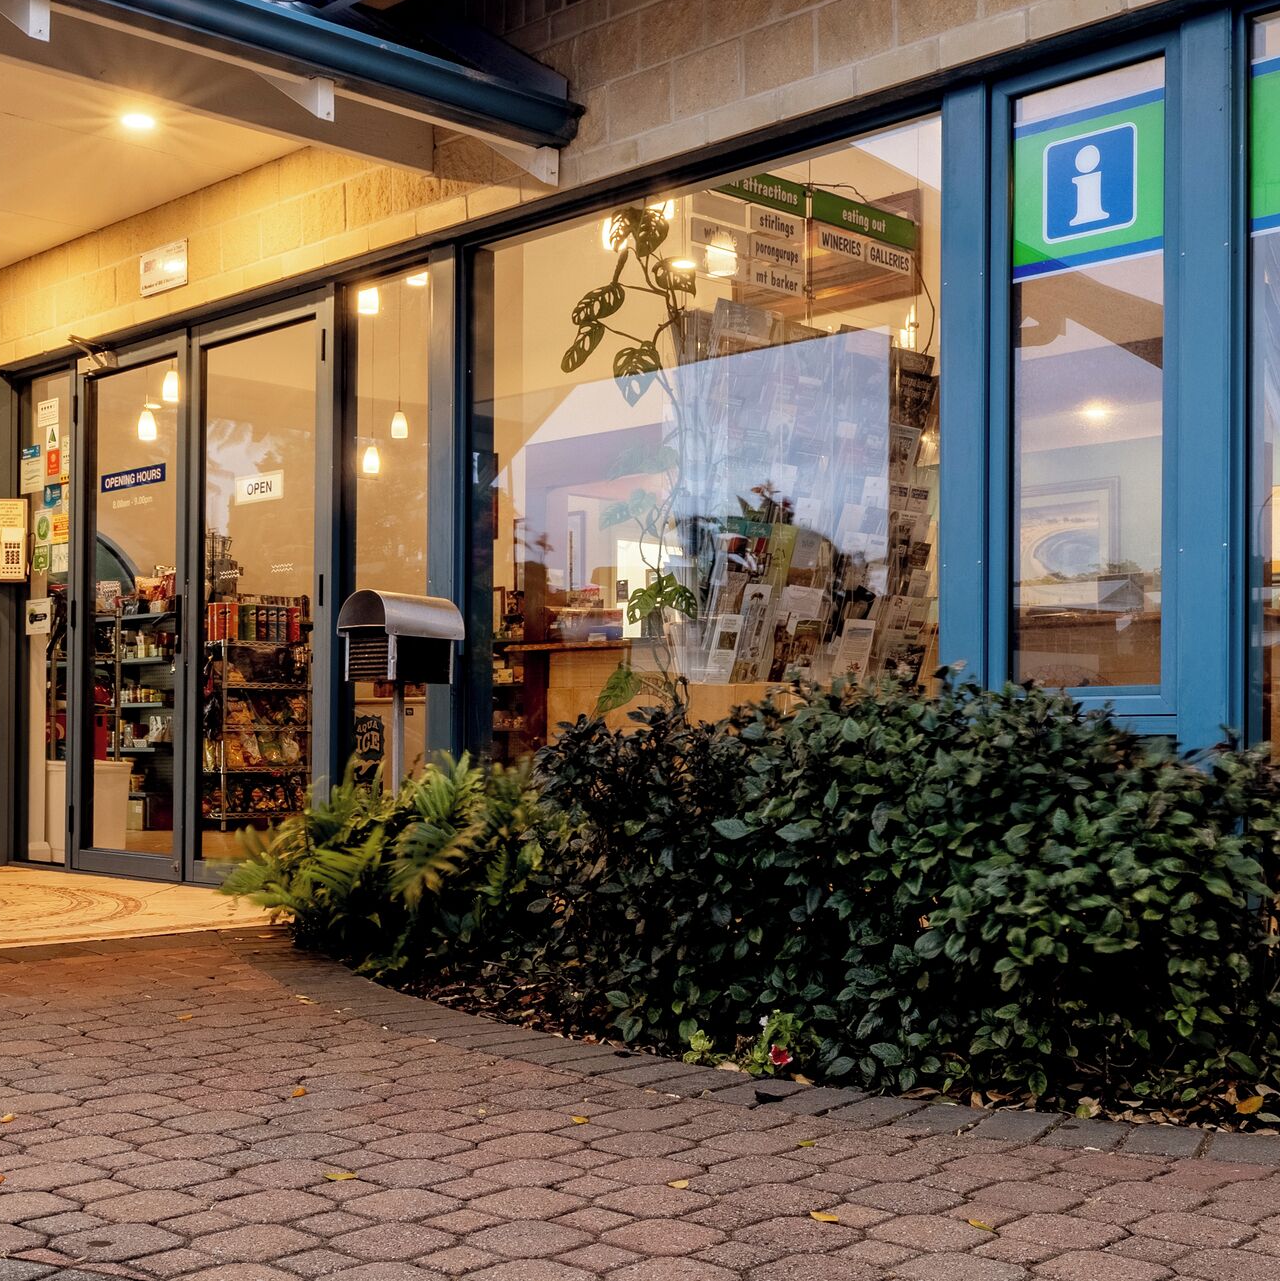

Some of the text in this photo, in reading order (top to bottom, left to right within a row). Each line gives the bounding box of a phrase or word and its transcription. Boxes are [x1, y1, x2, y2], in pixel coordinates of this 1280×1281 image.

[742, 177, 799, 206] attractions
[759, 214, 795, 238] stirlings
[842, 208, 886, 233] eating out
[755, 241, 799, 266] porongurups
[821, 231, 862, 257] WINERIES
[869, 246, 910, 272] GALLERIES
[756, 270, 798, 293] mt barker
[104, 468, 162, 489] OPENING HOURS
[246, 480, 273, 496] OPEN
[356, 720, 379, 733] AQUA
[355, 730, 381, 754] ICE
